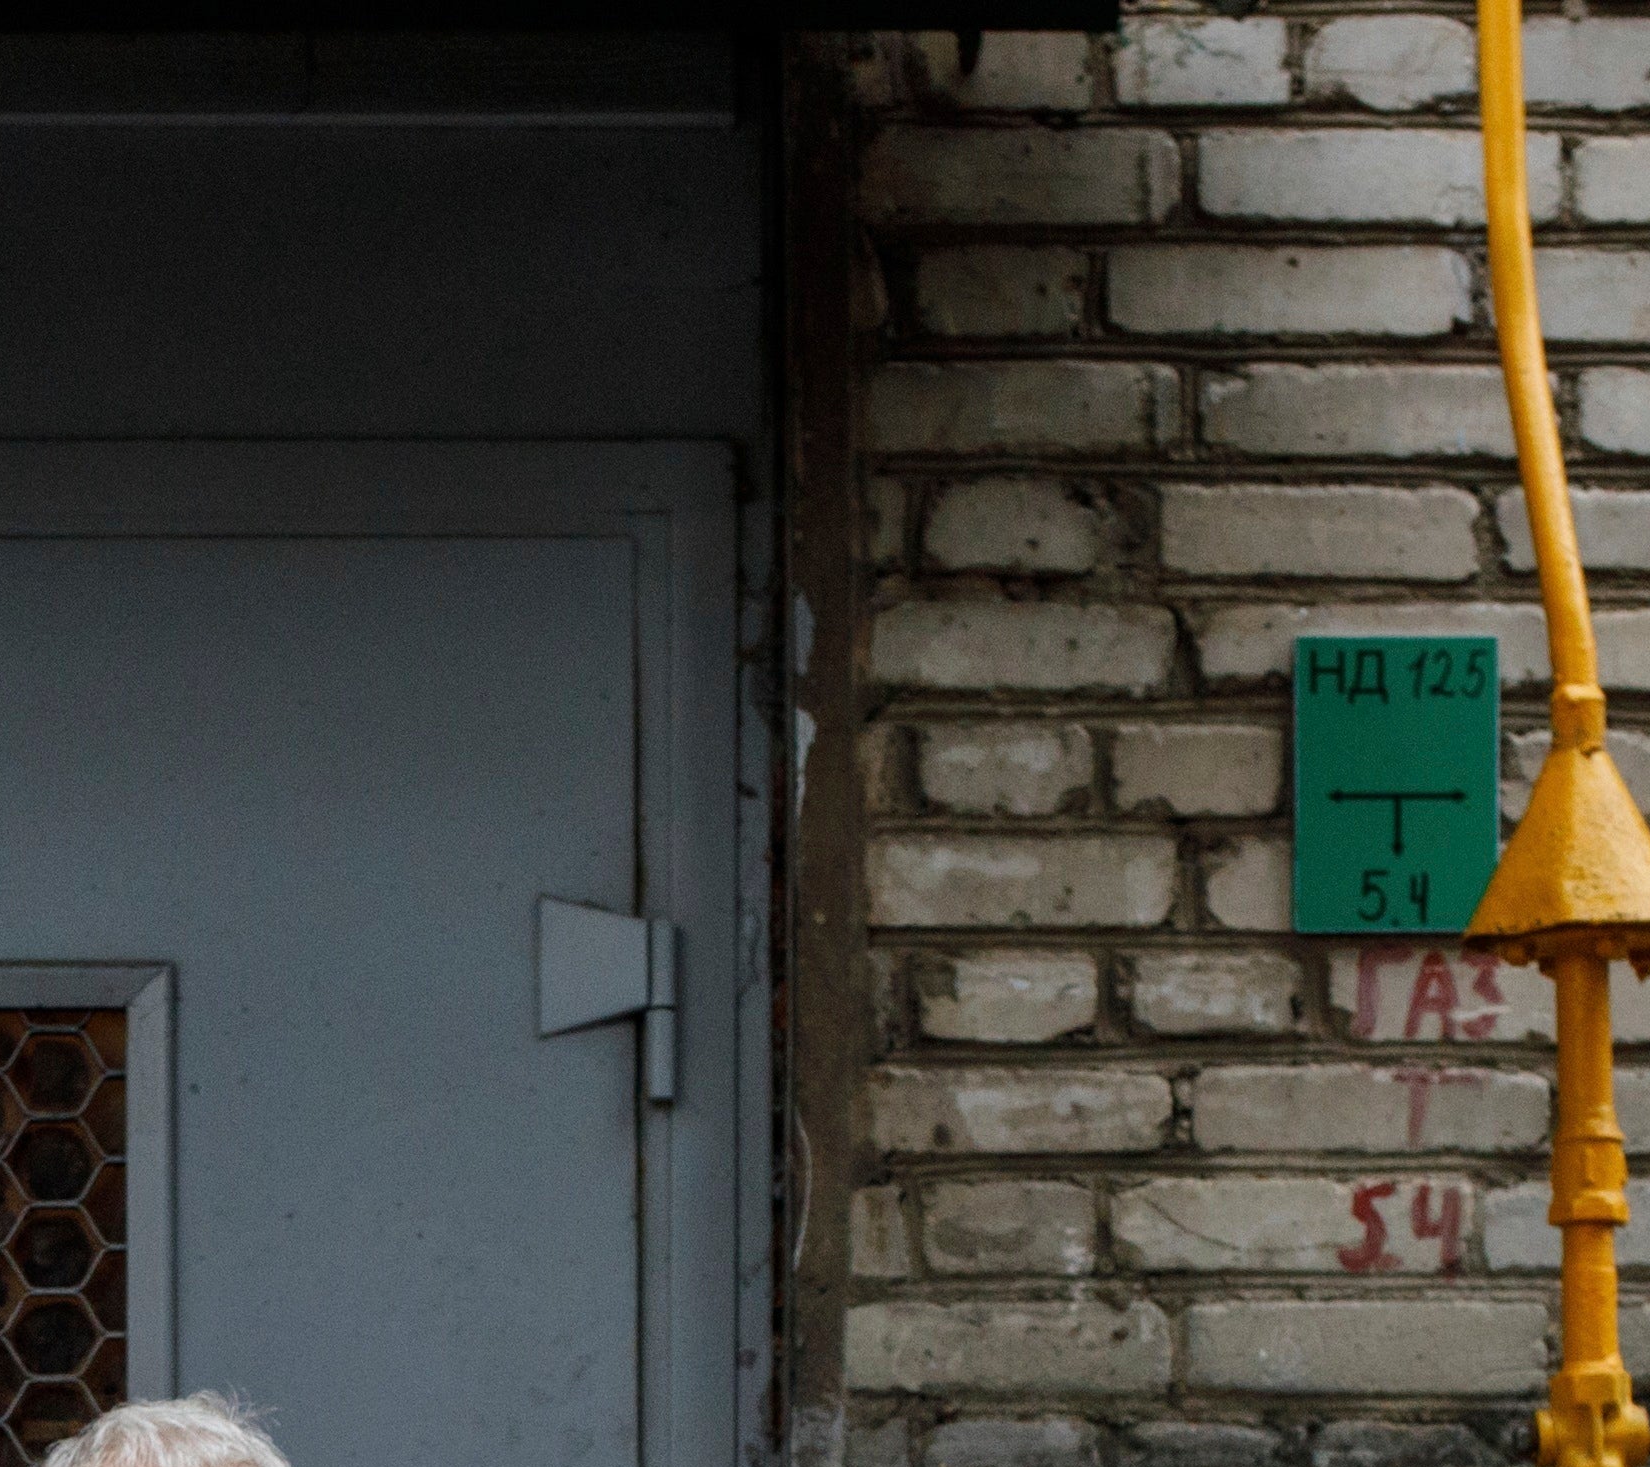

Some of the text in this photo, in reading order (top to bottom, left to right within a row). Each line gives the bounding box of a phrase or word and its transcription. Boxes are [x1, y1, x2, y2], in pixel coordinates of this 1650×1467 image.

[1308, 648, 1489, 702] НД 125
[1353, 948, 1505, 1040] ГАЗ
